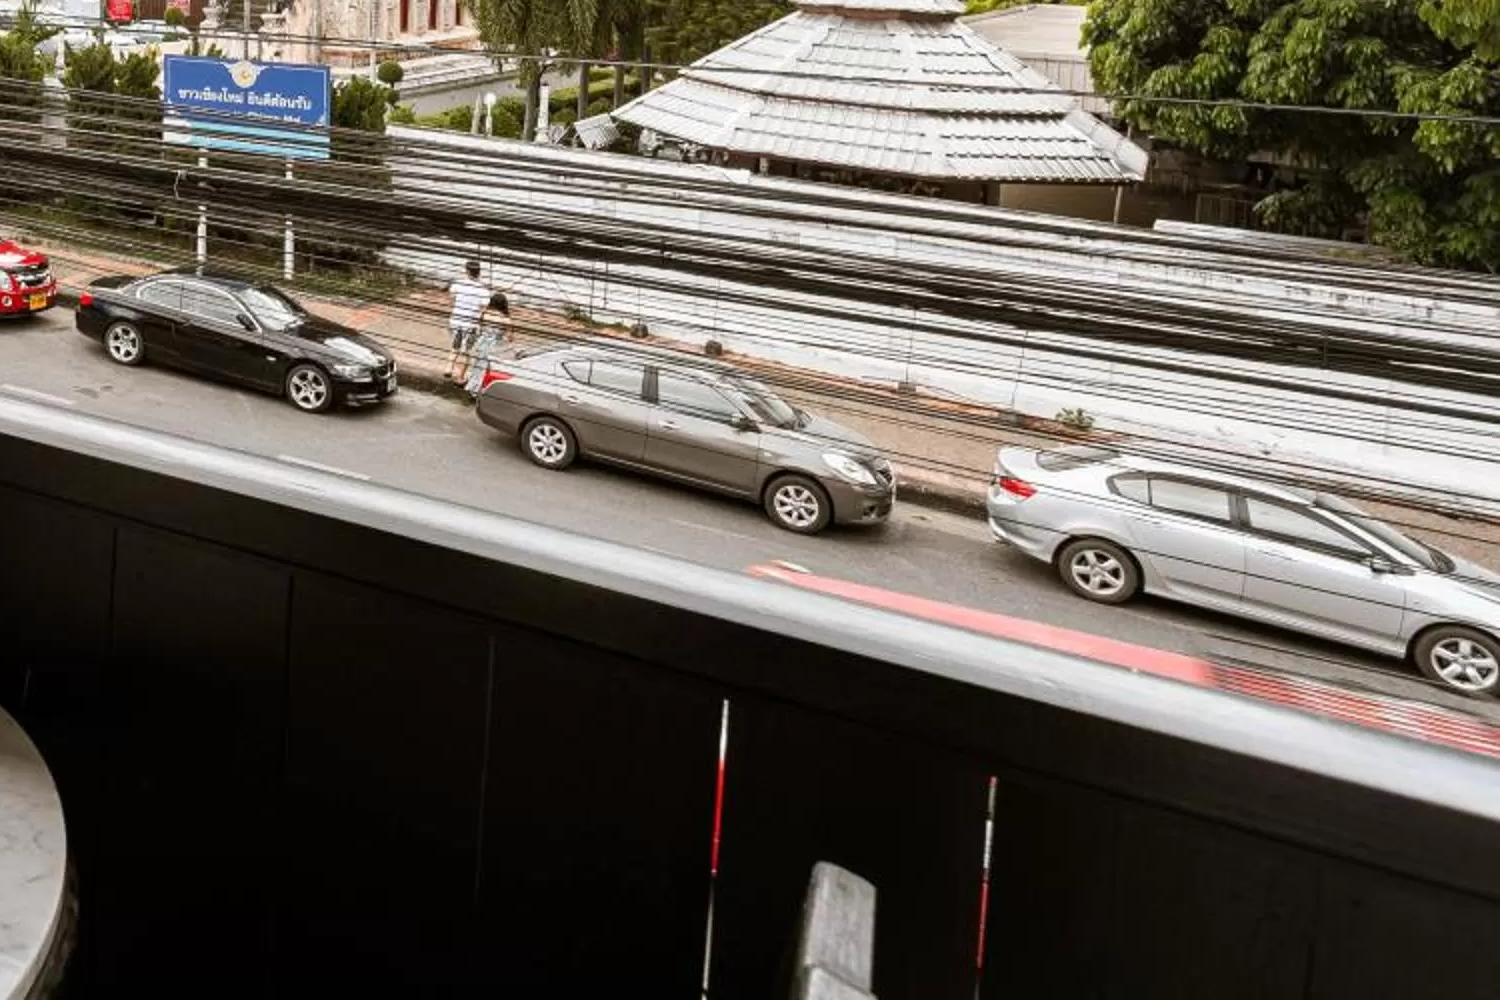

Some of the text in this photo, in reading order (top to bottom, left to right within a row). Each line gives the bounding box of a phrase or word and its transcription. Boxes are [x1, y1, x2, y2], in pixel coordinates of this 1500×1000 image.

[178, 86, 312, 111] ชาวเชียงใหม่ ยินดีต้อนรับ
